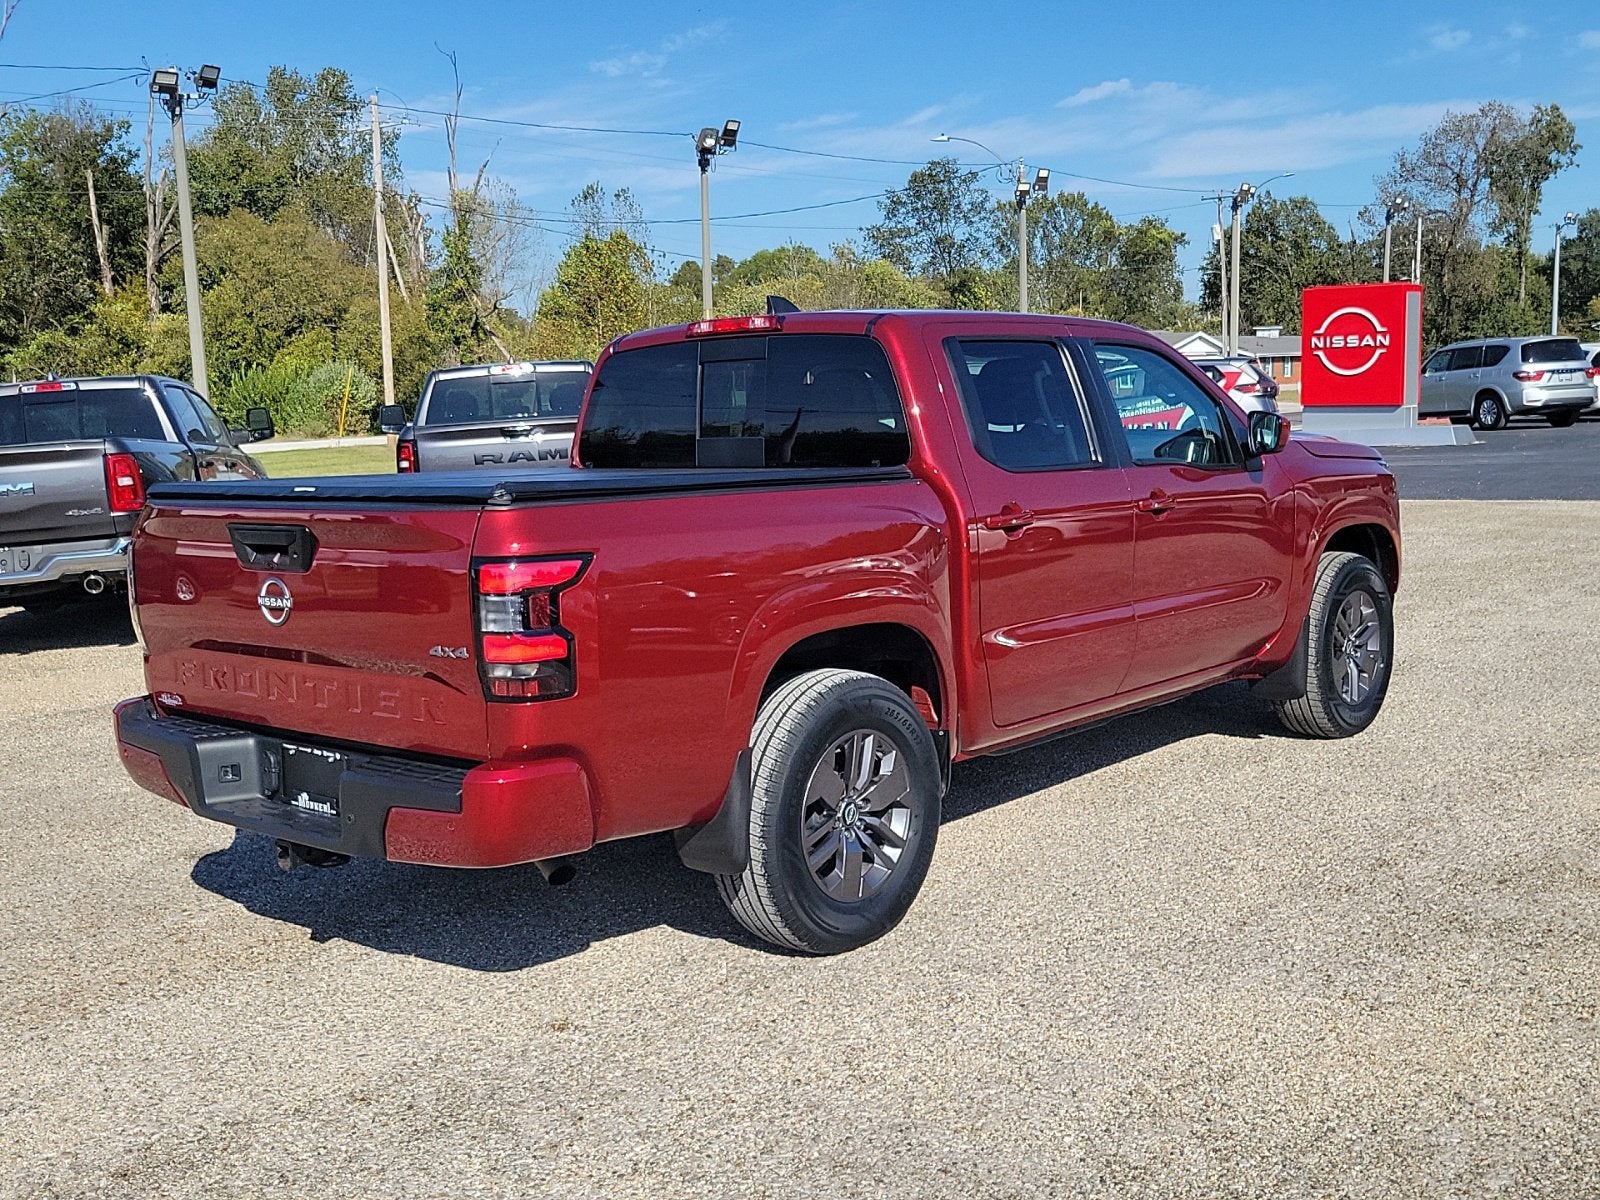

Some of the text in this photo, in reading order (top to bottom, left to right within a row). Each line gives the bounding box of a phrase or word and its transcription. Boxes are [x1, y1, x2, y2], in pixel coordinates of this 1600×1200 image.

[1311, 333, 1390, 349] NISSAN
[474, 447, 569, 466] RAM
[258, 596, 291, 608] NISSAN
[175, 659, 447, 725] FRONTIER
